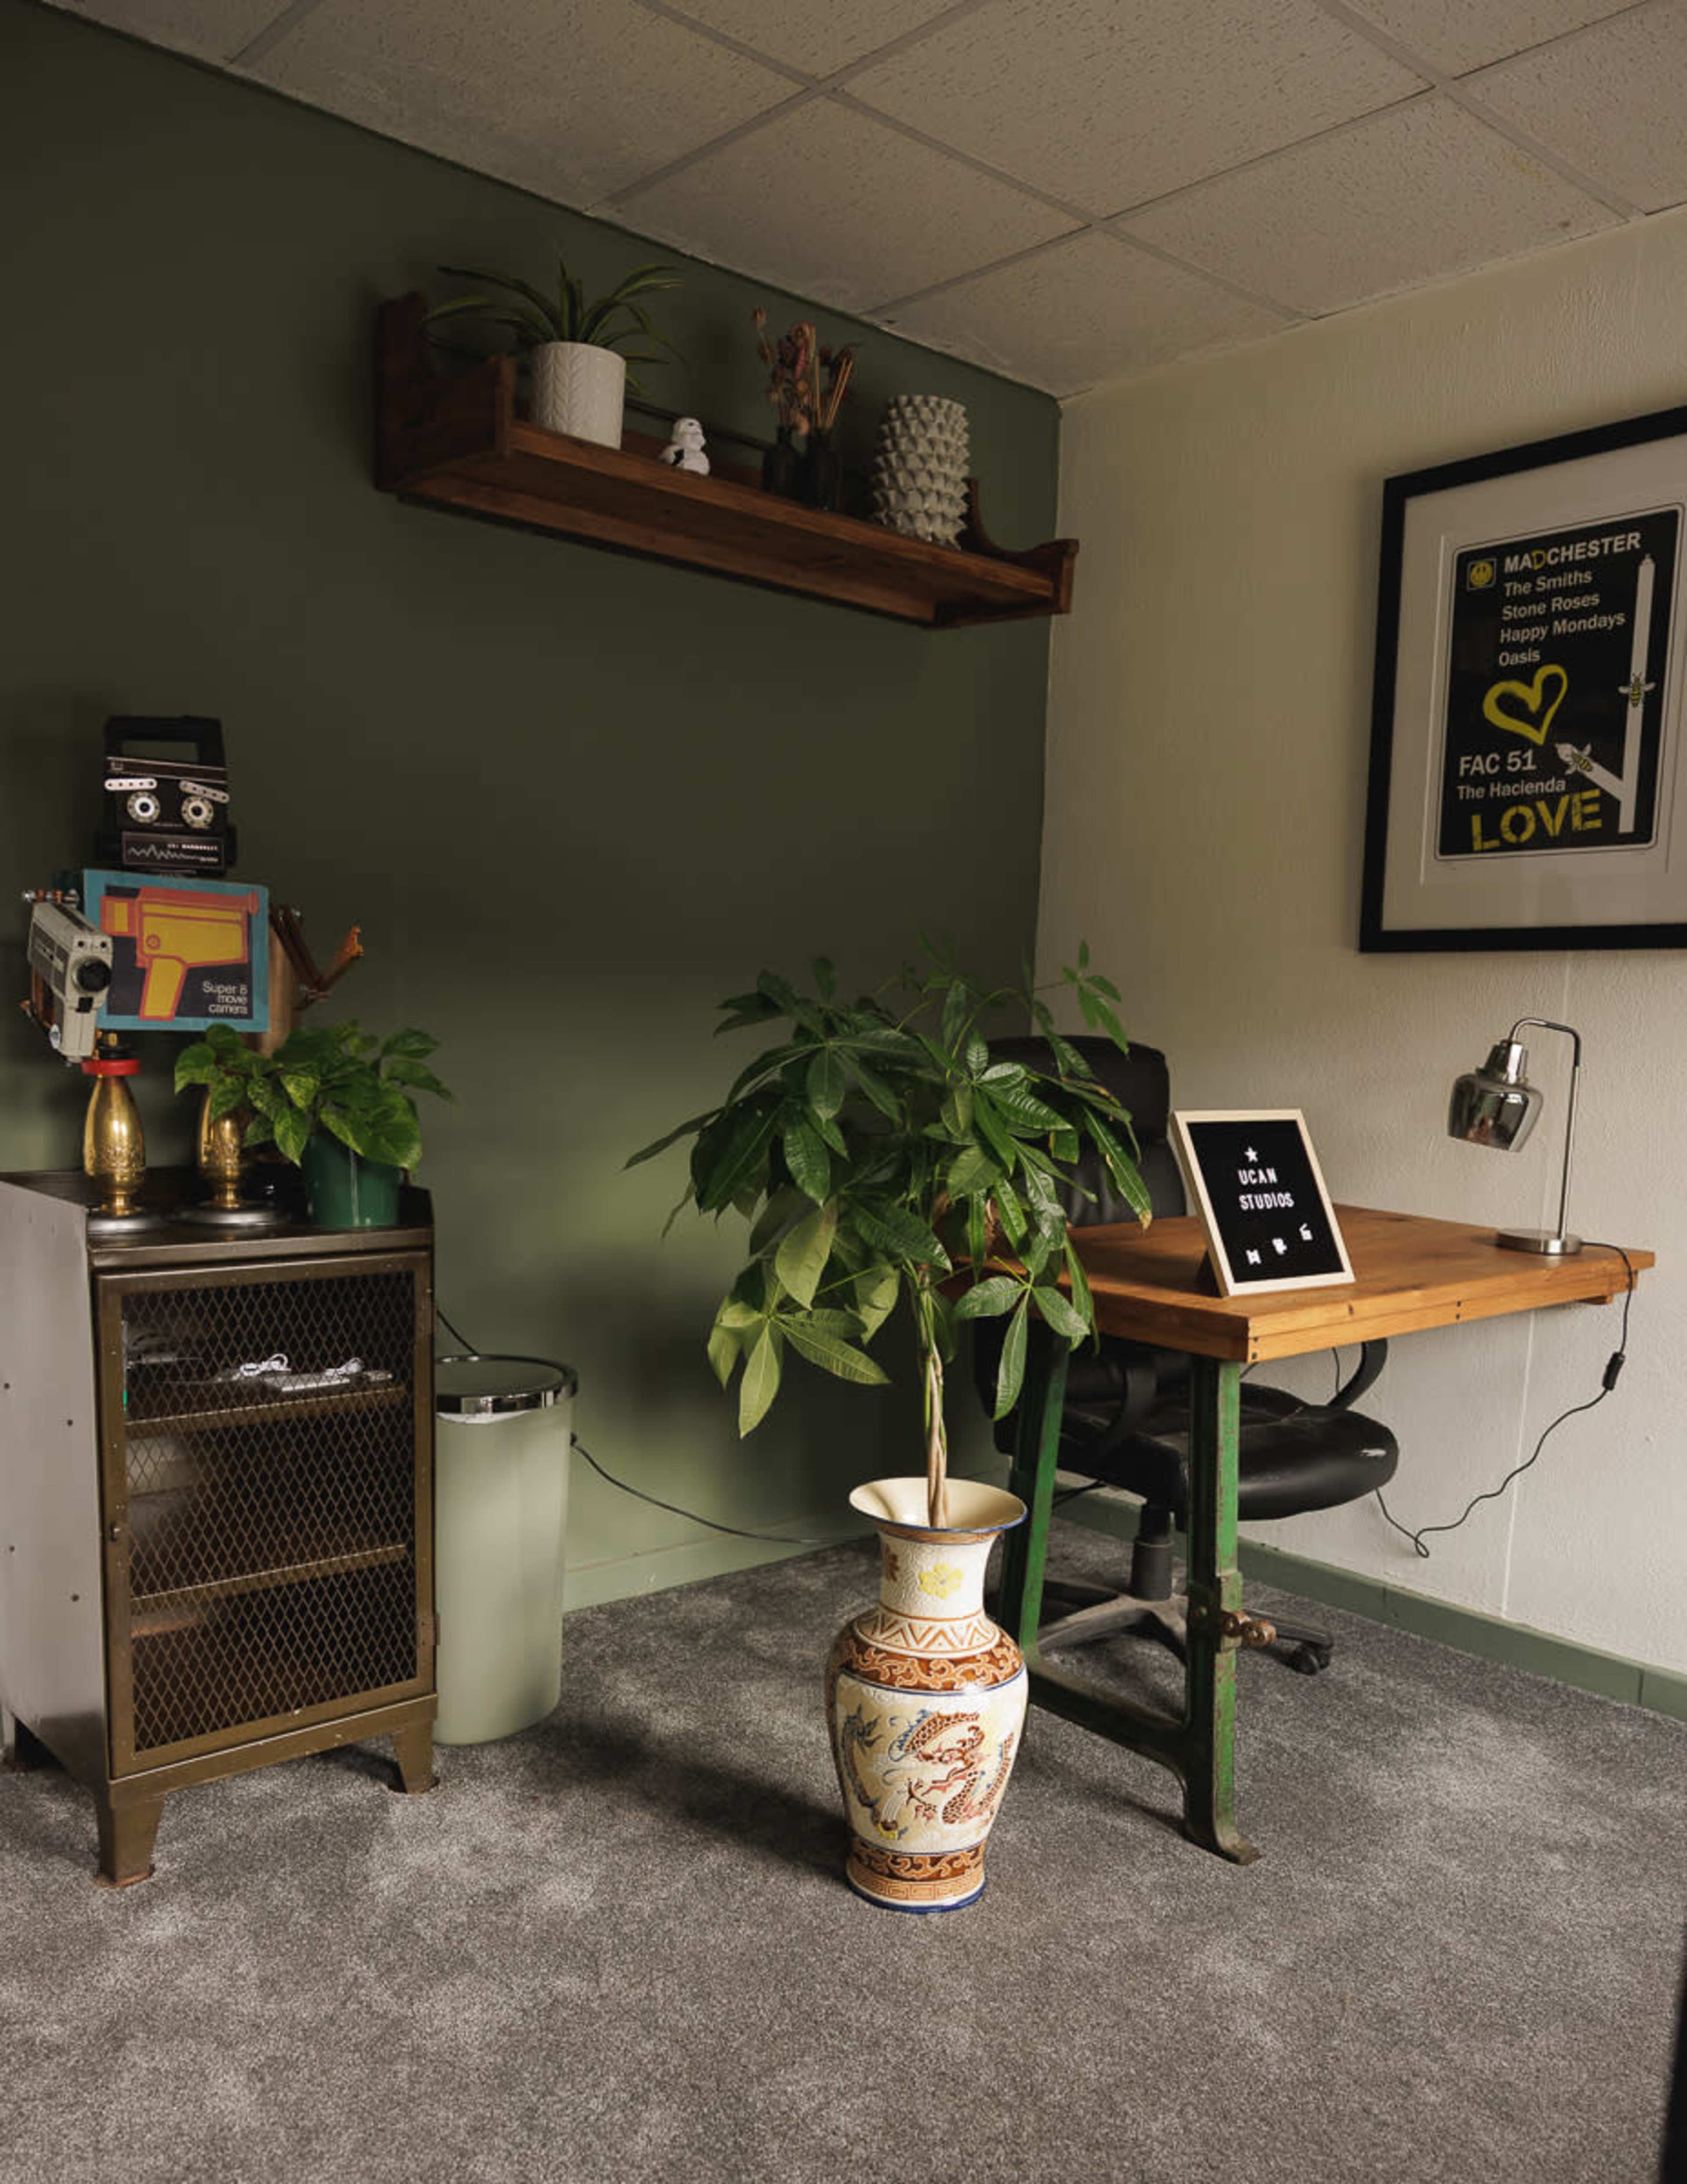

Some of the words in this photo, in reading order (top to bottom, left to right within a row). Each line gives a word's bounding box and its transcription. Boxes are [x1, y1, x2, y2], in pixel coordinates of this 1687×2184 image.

[1504, 532, 1641, 573] MADCHESTER
[1505, 582, 1531, 597] The
[1536, 570, 1593, 591] Smiths
[1502, 602, 1546, 620] Stone
[1551, 594, 1600, 612] Roses
[1500, 626, 1549, 643] Happy
[1553, 613, 1625, 634] Mondays
[1499, 648, 1540, 666] Oasis
[1459, 753, 1500, 777] FAC
[1506, 749, 1536, 771] 51
[1457, 785, 1484, 800] The
[1489, 777, 1566, 797] Hacienda
[1471, 789, 1602, 851] LOVE
[203, 980, 236, 994] Super
[208, 1004, 248, 1014] camera
[217, 995, 248, 1004] movie
[1238, 1167, 1278, 1185] UCAN
[1239, 1192, 1295, 1210] STUDIOS
